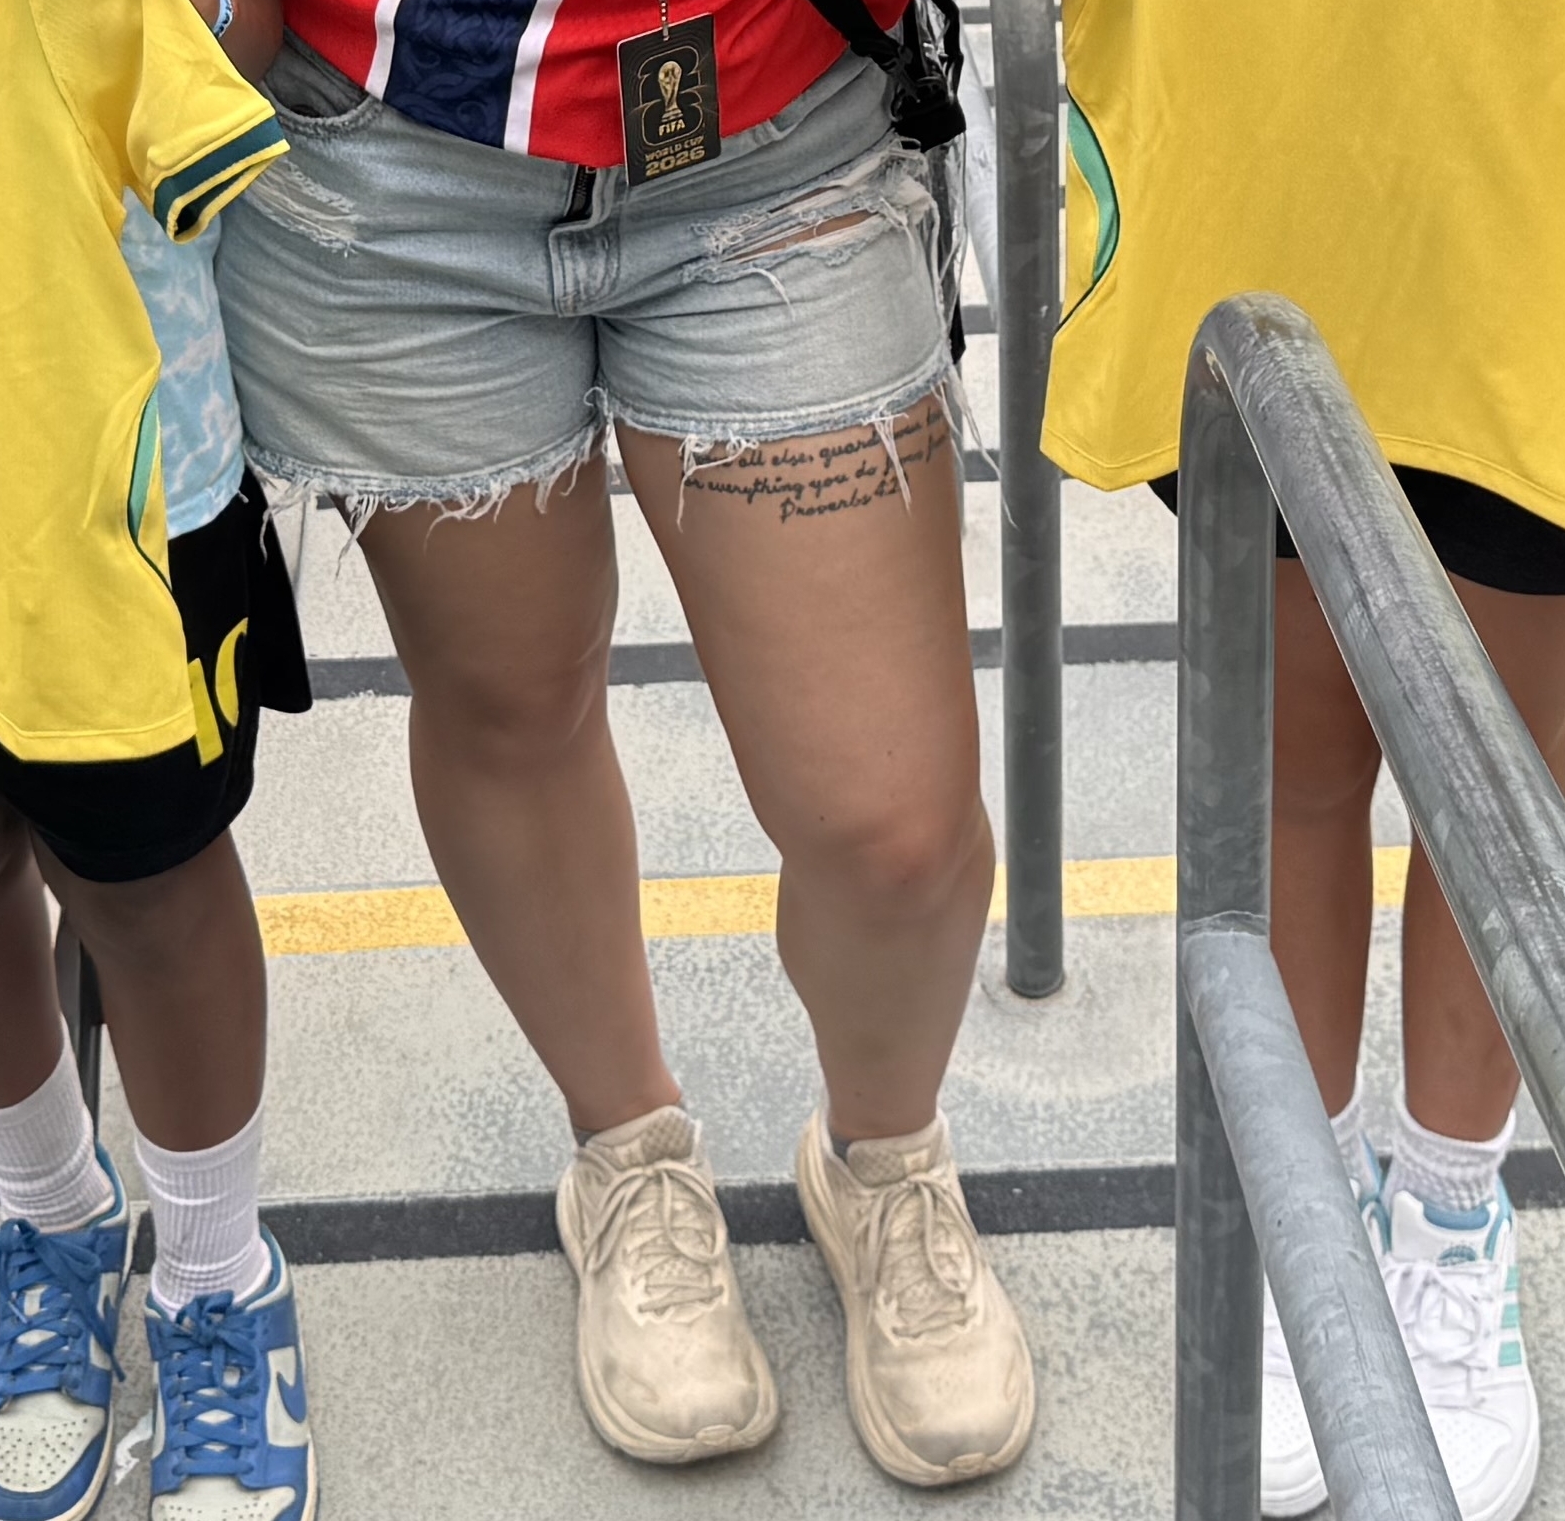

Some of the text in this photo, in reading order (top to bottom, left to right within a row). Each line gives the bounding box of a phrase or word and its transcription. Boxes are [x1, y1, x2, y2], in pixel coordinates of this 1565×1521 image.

[658, 118, 686, 136] FIFA
[645, 135, 704, 162] WORLD CUP
[645, 146, 705, 177] 2026
[708, 477, 804, 505] everything
[808, 474, 849, 499] you
[855, 460, 877, 479] do
[780, 487, 872, 524] Proverbs
